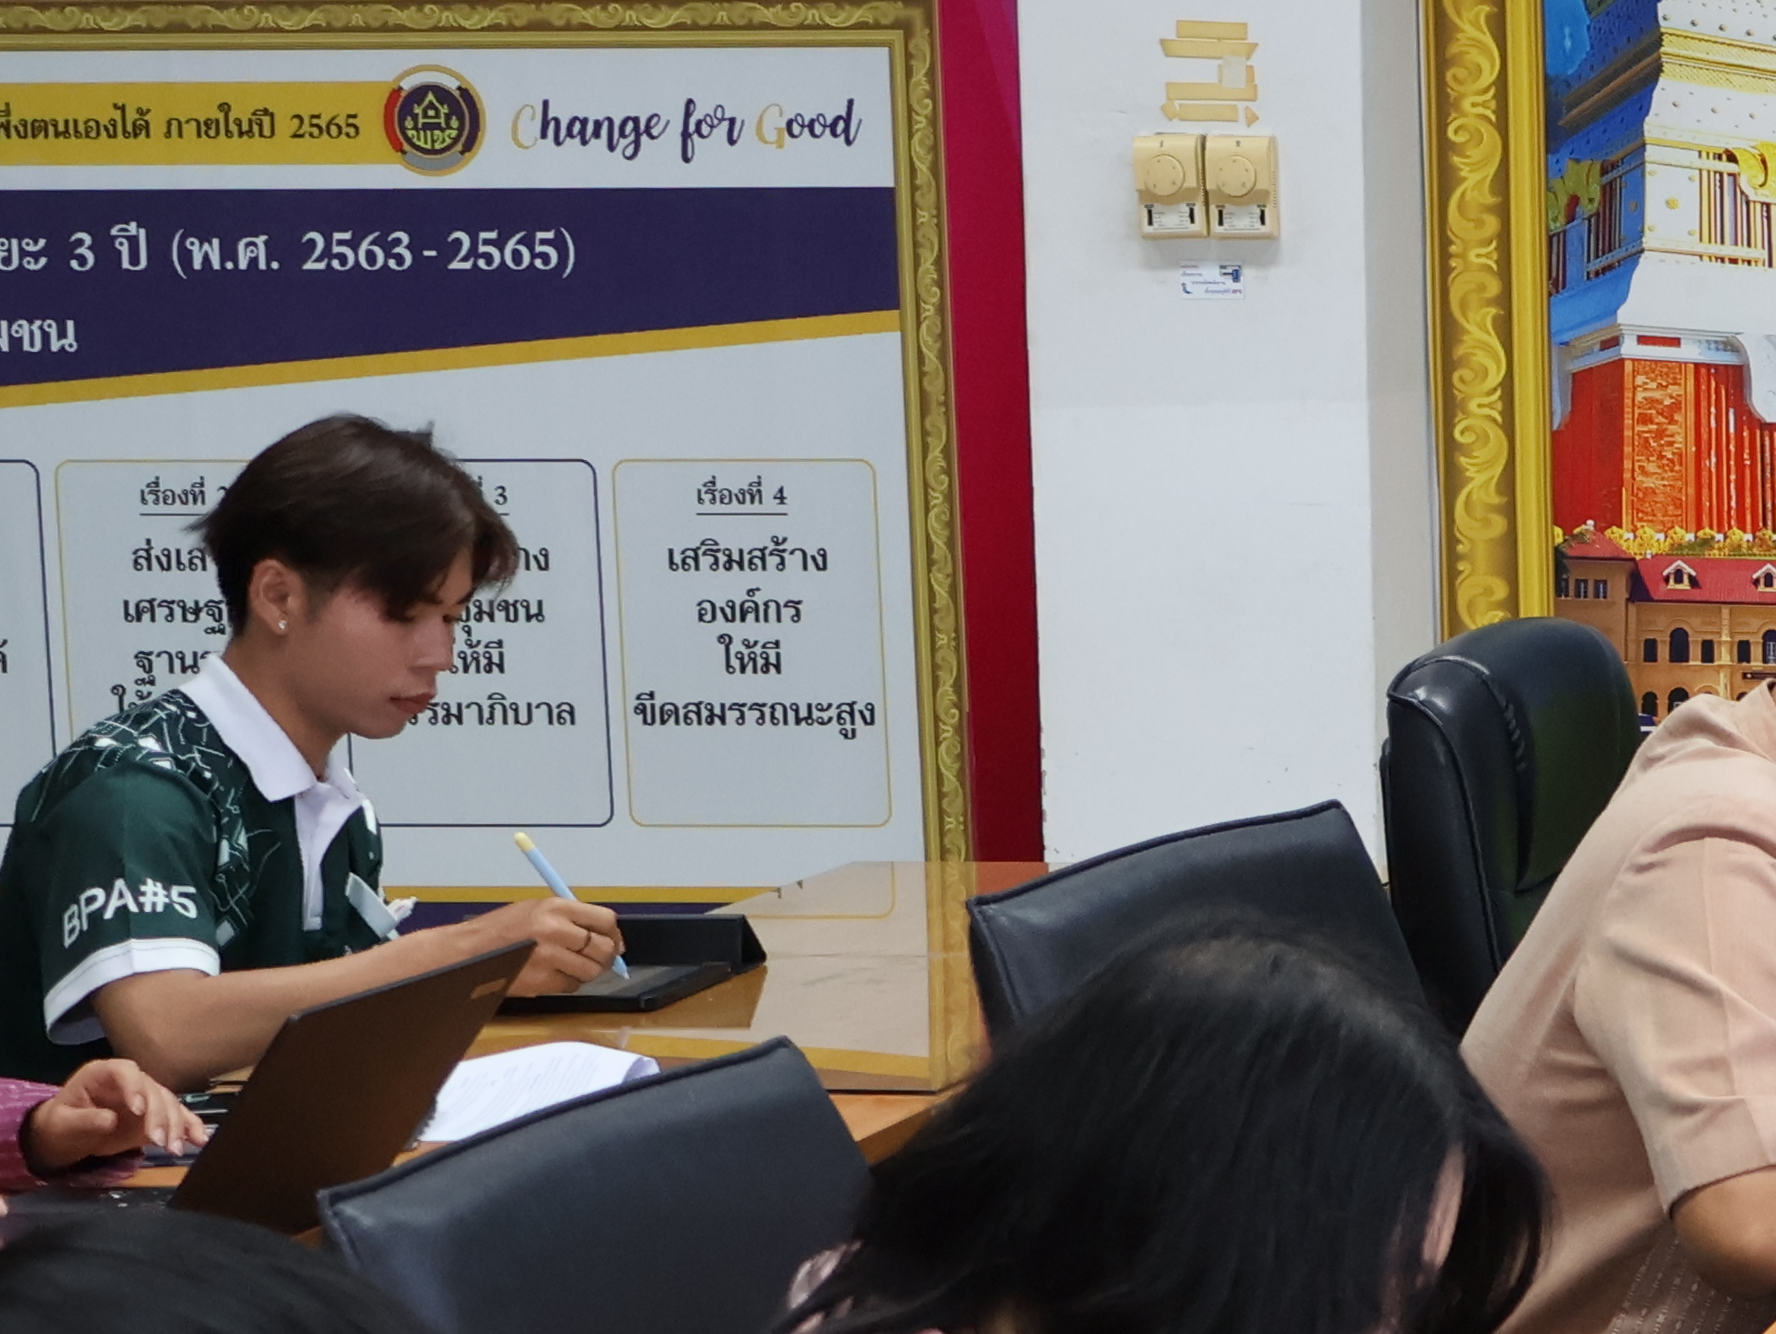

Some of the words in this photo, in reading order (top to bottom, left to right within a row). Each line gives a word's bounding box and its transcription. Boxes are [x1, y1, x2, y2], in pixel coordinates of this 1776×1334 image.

[163, 104, 275, 139] ภายในปี
[289, 114, 361, 139] 2565
[511, 98, 671, 161] Change
[680, 98, 745, 164] for
[755, 98, 863, 151] Good
[69, 231, 96, 272] 3
[110, 221, 147, 271] ปี
[172, 228, 280, 279] (พ.ศ.
[139, 475, 207, 507] เรื่องที่
[493, 486, 508, 505] 3
[696, 475, 763, 507] เรื่องที่
[772, 486, 788, 505] 4
[667, 535, 828, 572] เสริมสร้าง
[122, 598, 228, 635] เศรษฐ
[697, 587, 803, 624] องค์กร
[716, 633, 782, 675] ให้มี
[633, 690, 877, 741] ขีดสมรรถนะสูง
[63, 877, 198, 950] BPA#5
